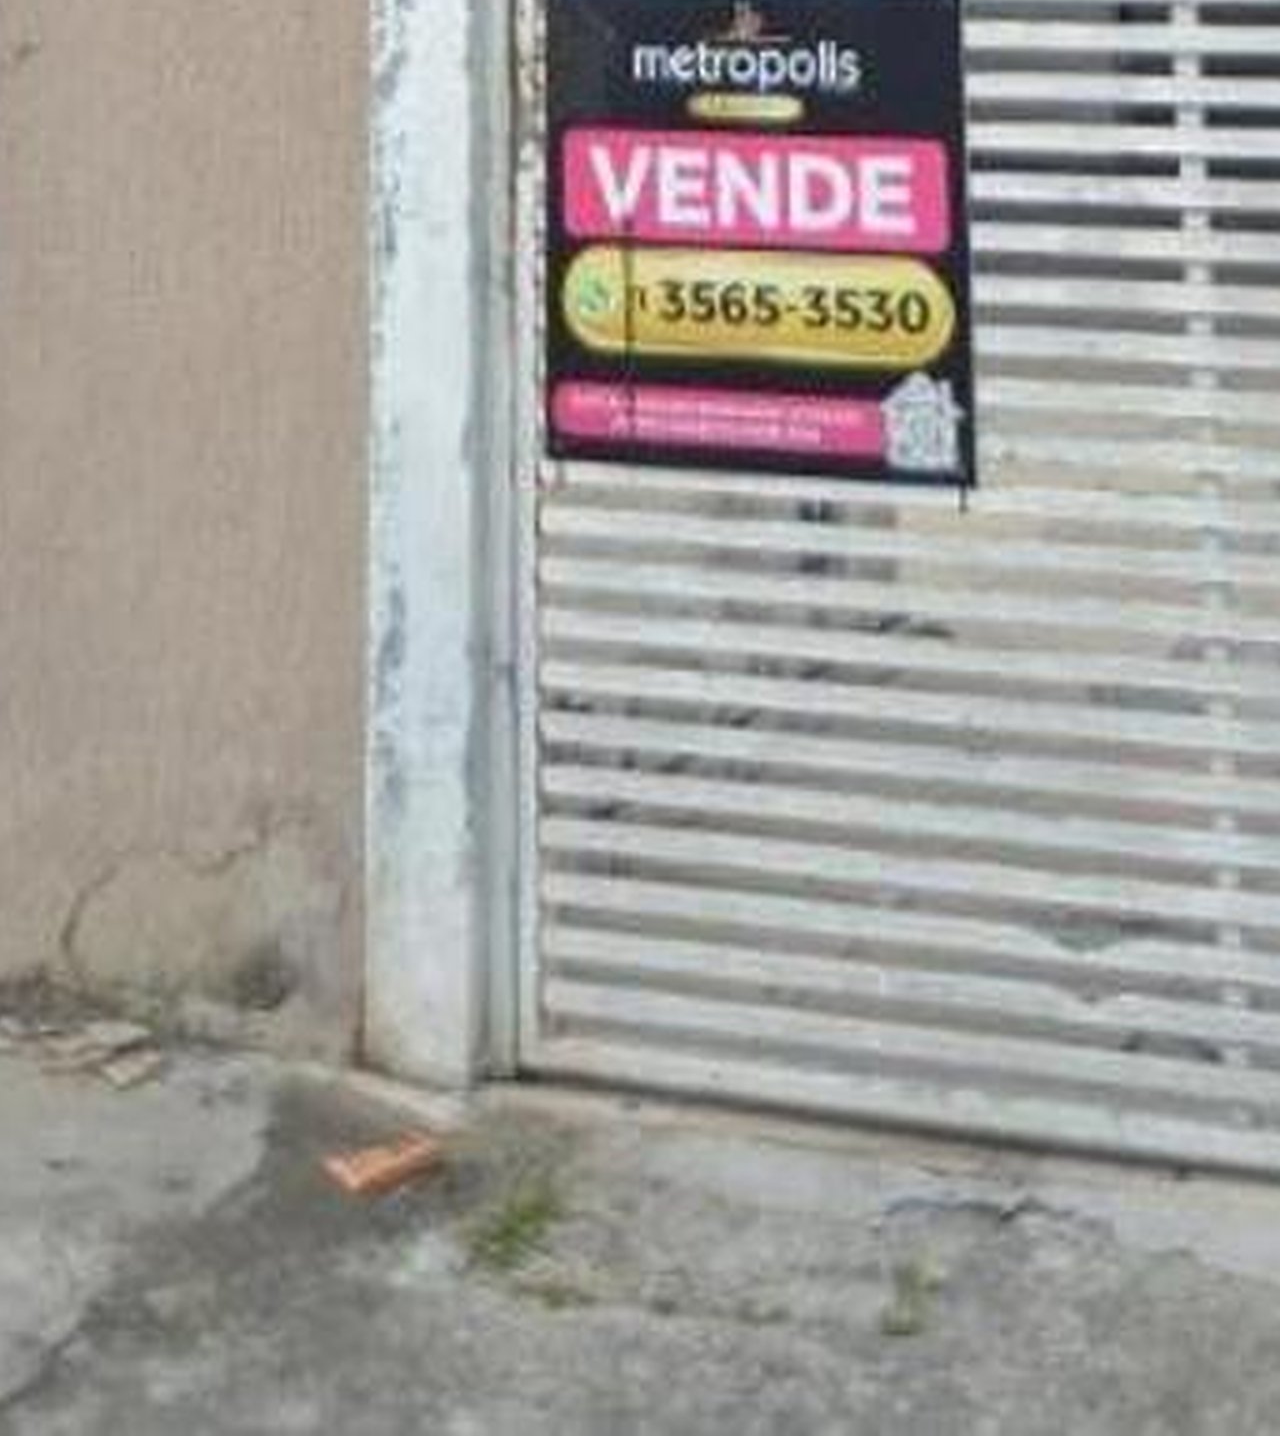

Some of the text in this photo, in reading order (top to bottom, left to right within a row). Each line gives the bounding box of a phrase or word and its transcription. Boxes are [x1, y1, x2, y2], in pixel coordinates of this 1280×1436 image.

[634, 41, 862, 91] metropolis
[588, 146, 918, 236] VENDE
[656, 278, 932, 335] 3565-3530
